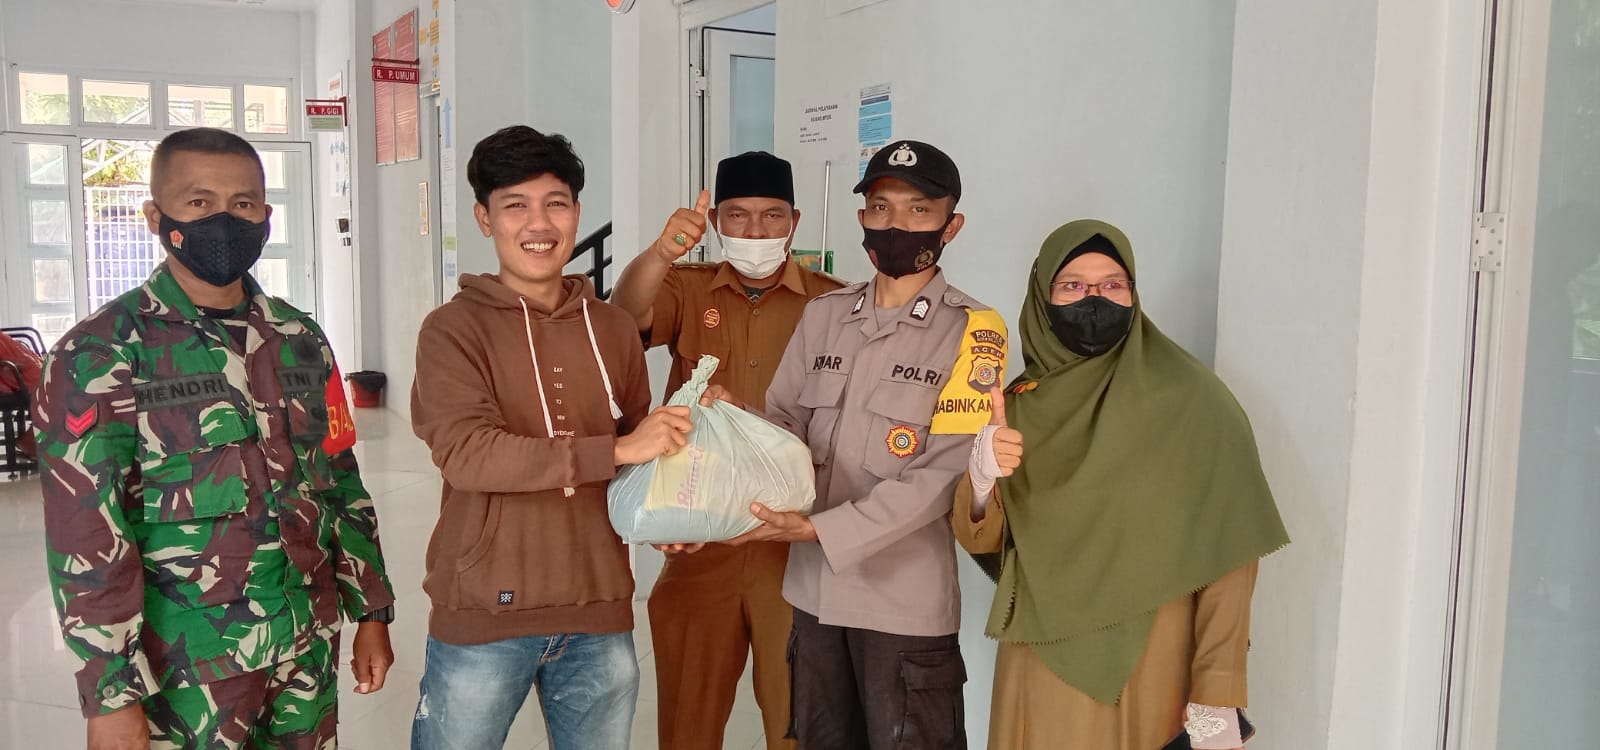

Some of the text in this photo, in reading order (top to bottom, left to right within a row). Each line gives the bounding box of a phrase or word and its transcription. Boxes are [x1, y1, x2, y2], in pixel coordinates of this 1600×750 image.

[975, 331, 1003, 344] POLRES
[974, 346, 1002, 358] ACEH
[283, 371, 312, 388] TNI
[891, 364, 942, 386] POLRI
[137, 379, 226, 404] HENDRI
